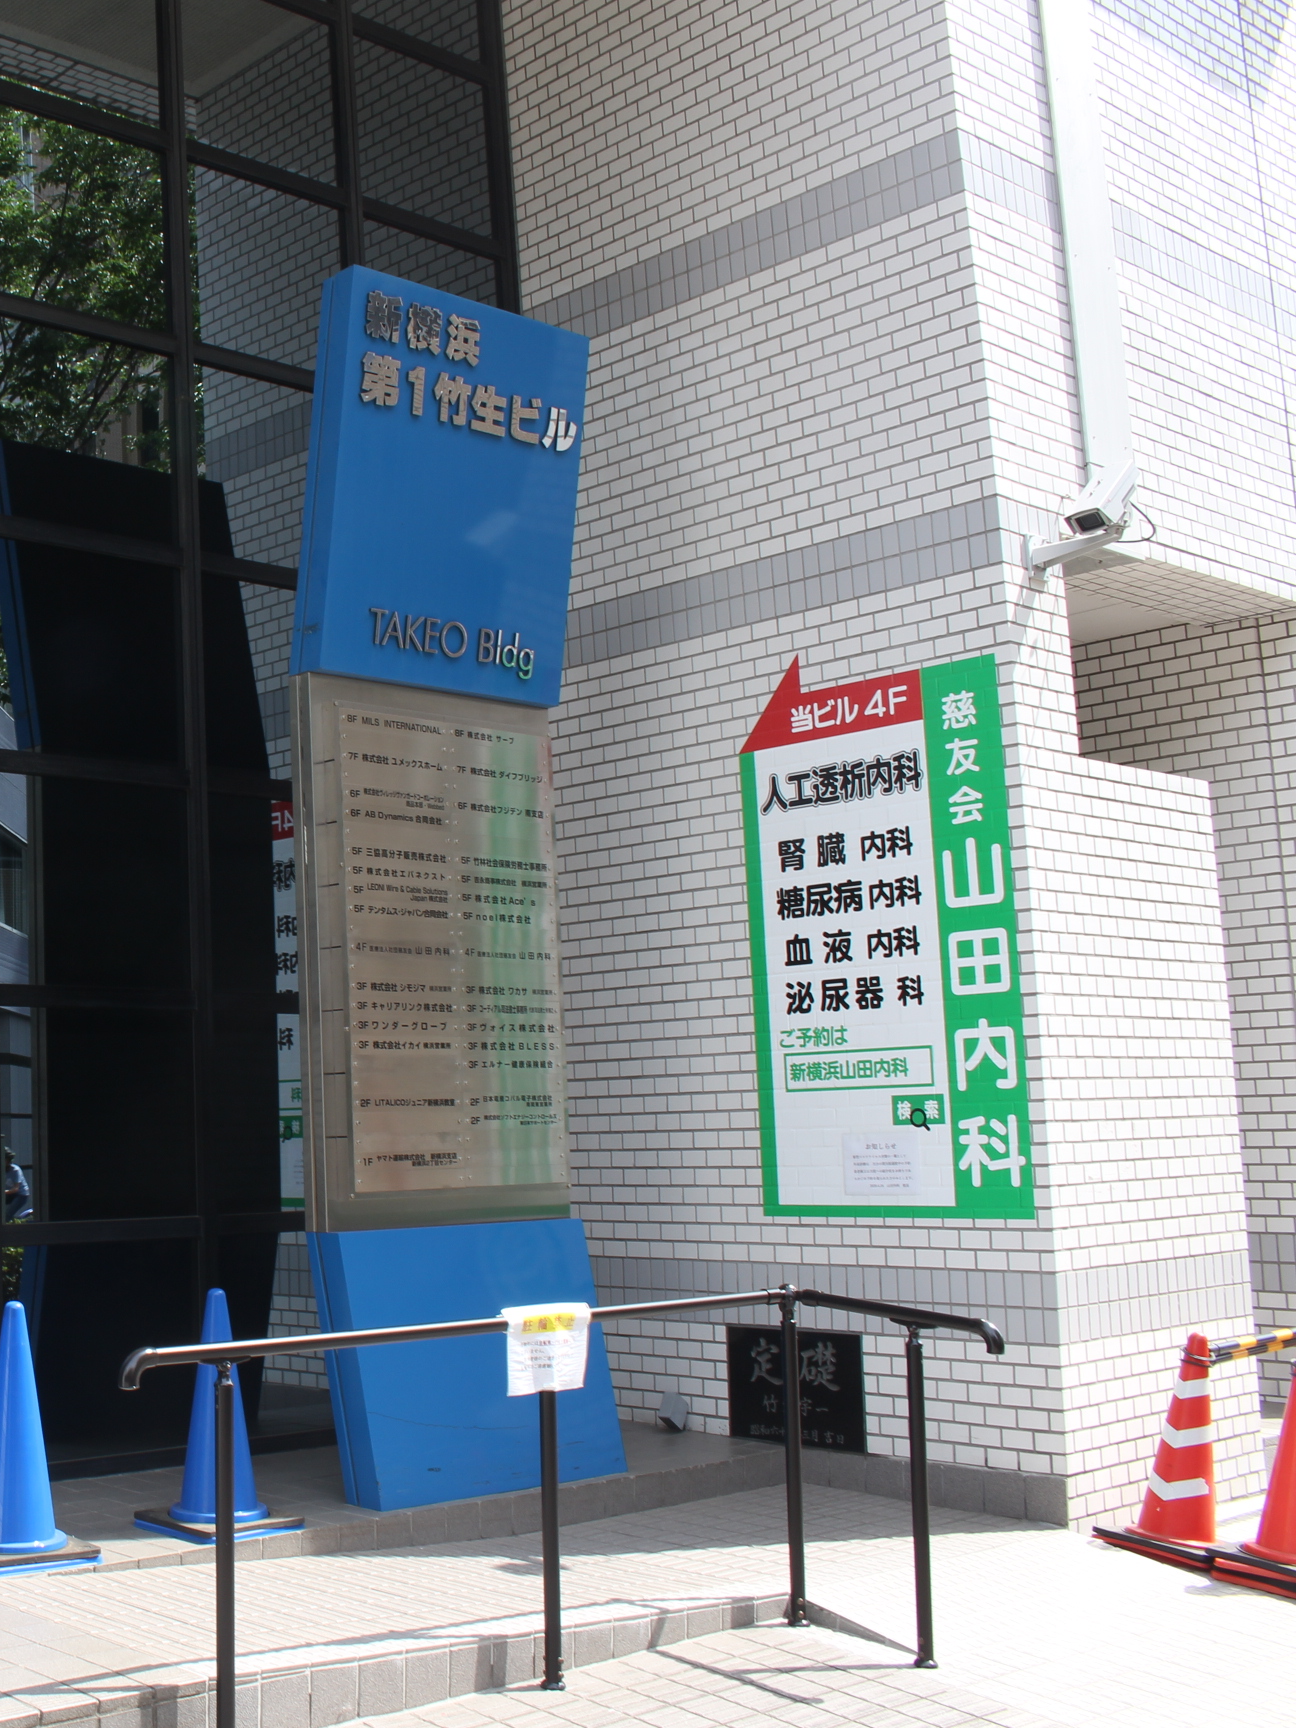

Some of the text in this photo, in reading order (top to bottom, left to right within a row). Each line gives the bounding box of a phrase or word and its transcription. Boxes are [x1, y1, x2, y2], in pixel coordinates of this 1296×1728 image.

[365, 290, 481, 367] 新横浜
[360, 351, 577, 452] 第1竹生ビル
[370, 607, 534, 680] TAKEO Bldg
[790, 685, 908, 733] 当ビル 4F
[346, 714, 442, 734] 8F MILS INTERNATIONAL
[454, 729, 464, 737] 8F
[467, 732, 492, 742] 株式会社
[348, 752, 442, 771] 7F 株式会社 ユメックスホーム
[456, 765, 466, 774] 7F
[470, 767, 497, 778] 株式会社
[761, 748, 923, 816] 人工透析内科
[350, 790, 360, 798] 6F
[458, 802, 468, 810] 6F
[350, 808, 442, 826] 6F AB Dynamics 合同会社
[352, 847, 362, 855] 5F
[461, 856, 471, 864] 5F
[352, 866, 364, 874] 5F
[461, 875, 471, 884] 5F
[354, 886, 364, 894] 5F
[367, 883, 385, 892] LEONI
[386, 884, 399, 892] Wire
[406, 886, 422, 894] Cable
[422, 886, 448, 896] Solutions
[410, 894, 428, 902] Japan
[462, 894, 472, 902] 5F
[354, 904, 365, 913] 5F
[463, 912, 473, 920] 5F
[941, 690, 1026, 1188] 慈友会 山田内科
[356, 942, 367, 952] 4F
[415, 946, 450, 956] 山田内科
[465, 948, 476, 956] 4F
[518, 952, 551, 960] 山田内科
[356, 982, 368, 990] 3F
[370, 982, 398, 992] 株式会社
[400, 984, 426, 992] シモジマ
[466, 986, 476, 994] 3F
[478, 986, 506, 996] 株式会社
[508, 987, 528, 996] ワカサ
[356, 1002, 453, 1013] 3F キャリアリンク株式会社
[466, 1004, 476, 1012] 3F
[358, 1021, 369, 1030] 3F
[467, 1023, 555, 1033] 3F ヴォイス株式会社
[779, 1025, 849, 1049] ご予約は
[358, 1040, 370, 1050] 3F
[372, 1041, 420, 1050] 株式会社イカイ
[468, 1042, 478, 1050] 3F
[468, 1060, 478, 1068] 3F
[789, 1057, 909, 1083] 新横浜山田内科
[360, 1098, 371, 1108] 2F
[470, 1098, 480, 1106] 2F
[896, 1100, 940, 1120] 検索
[470, 1116, 480, 1125] 2F
[362, 1158, 374, 1166] 1F
[750, 1337, 841, 1392] 定礎
